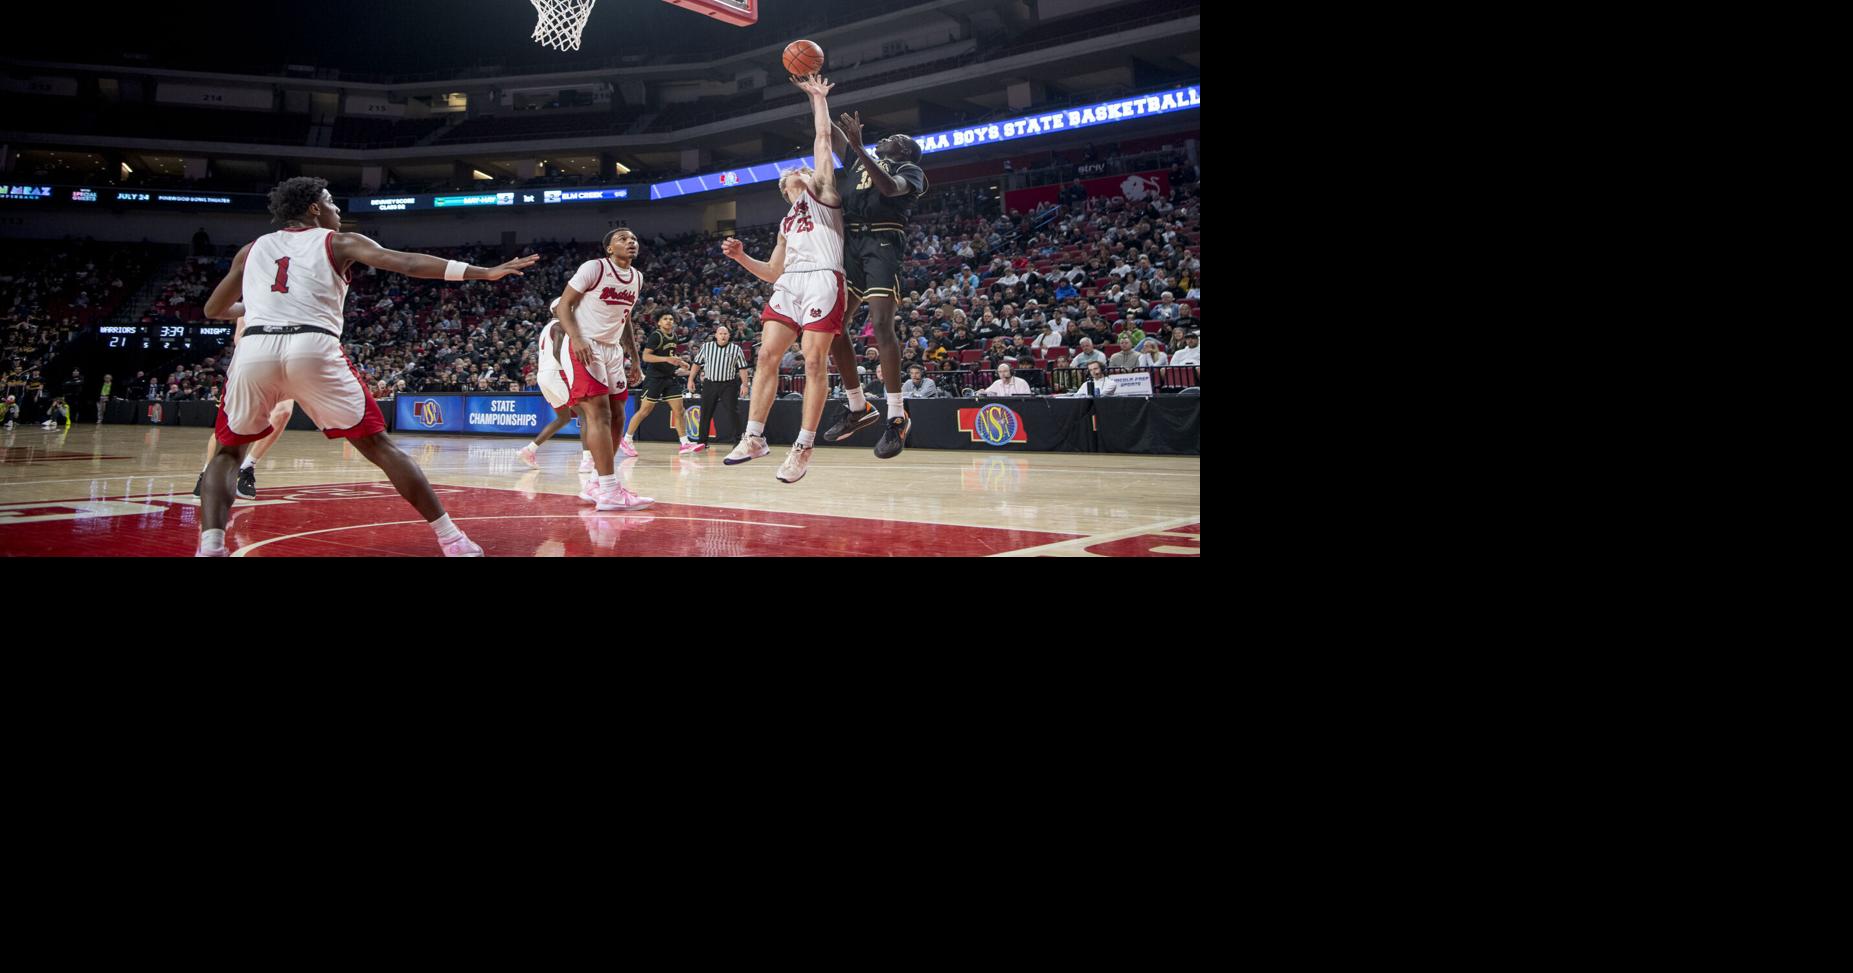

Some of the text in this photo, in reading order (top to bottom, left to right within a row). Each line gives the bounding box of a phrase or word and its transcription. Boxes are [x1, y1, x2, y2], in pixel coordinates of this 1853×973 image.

[368, 104, 386, 112] 215
[916, 89, 1200, 152] SAA BOYS STATE BASKETBALL
[561, 191, 604, 200] ELM CREEK
[797, 215, 814, 233] 25
[271, 256, 290, 293] 1
[99, 326, 137, 334] WARRIORS
[160, 326, 184, 337] 3:39
[109, 337, 127, 347] 21
[490, 400, 516, 412] STATE
[469, 412, 537, 426] CHAMPIONSHIPS
